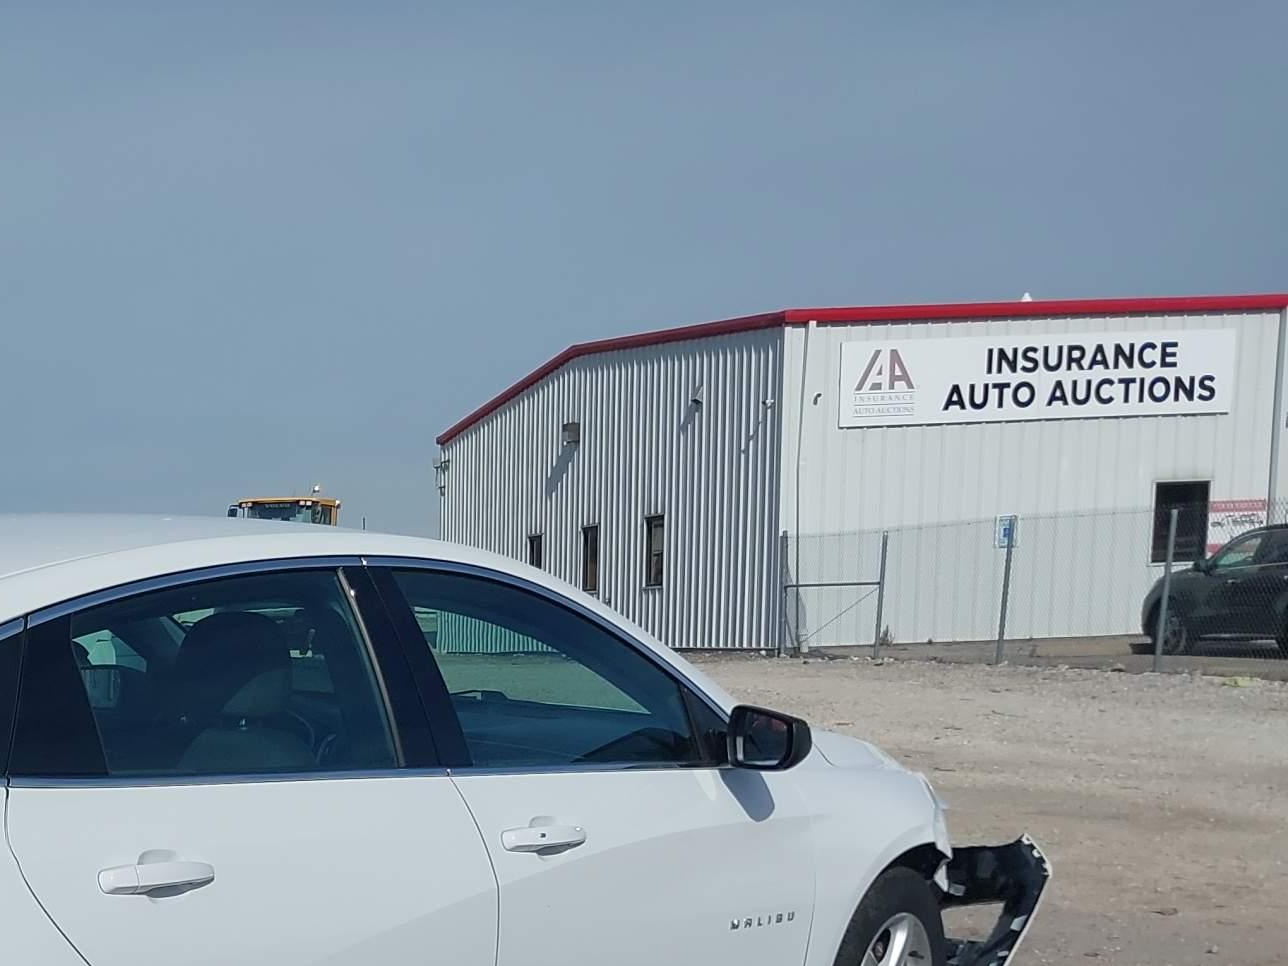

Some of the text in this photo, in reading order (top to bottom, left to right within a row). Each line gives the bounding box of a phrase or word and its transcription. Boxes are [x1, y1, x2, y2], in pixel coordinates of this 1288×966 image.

[986, 341, 1178, 375] INSURANCE
[853, 394, 914, 402] INSURANCE
[942, 374, 1216, 411] AUTO AUCTIONS
[730, 911, 795, 930] MALIBU
